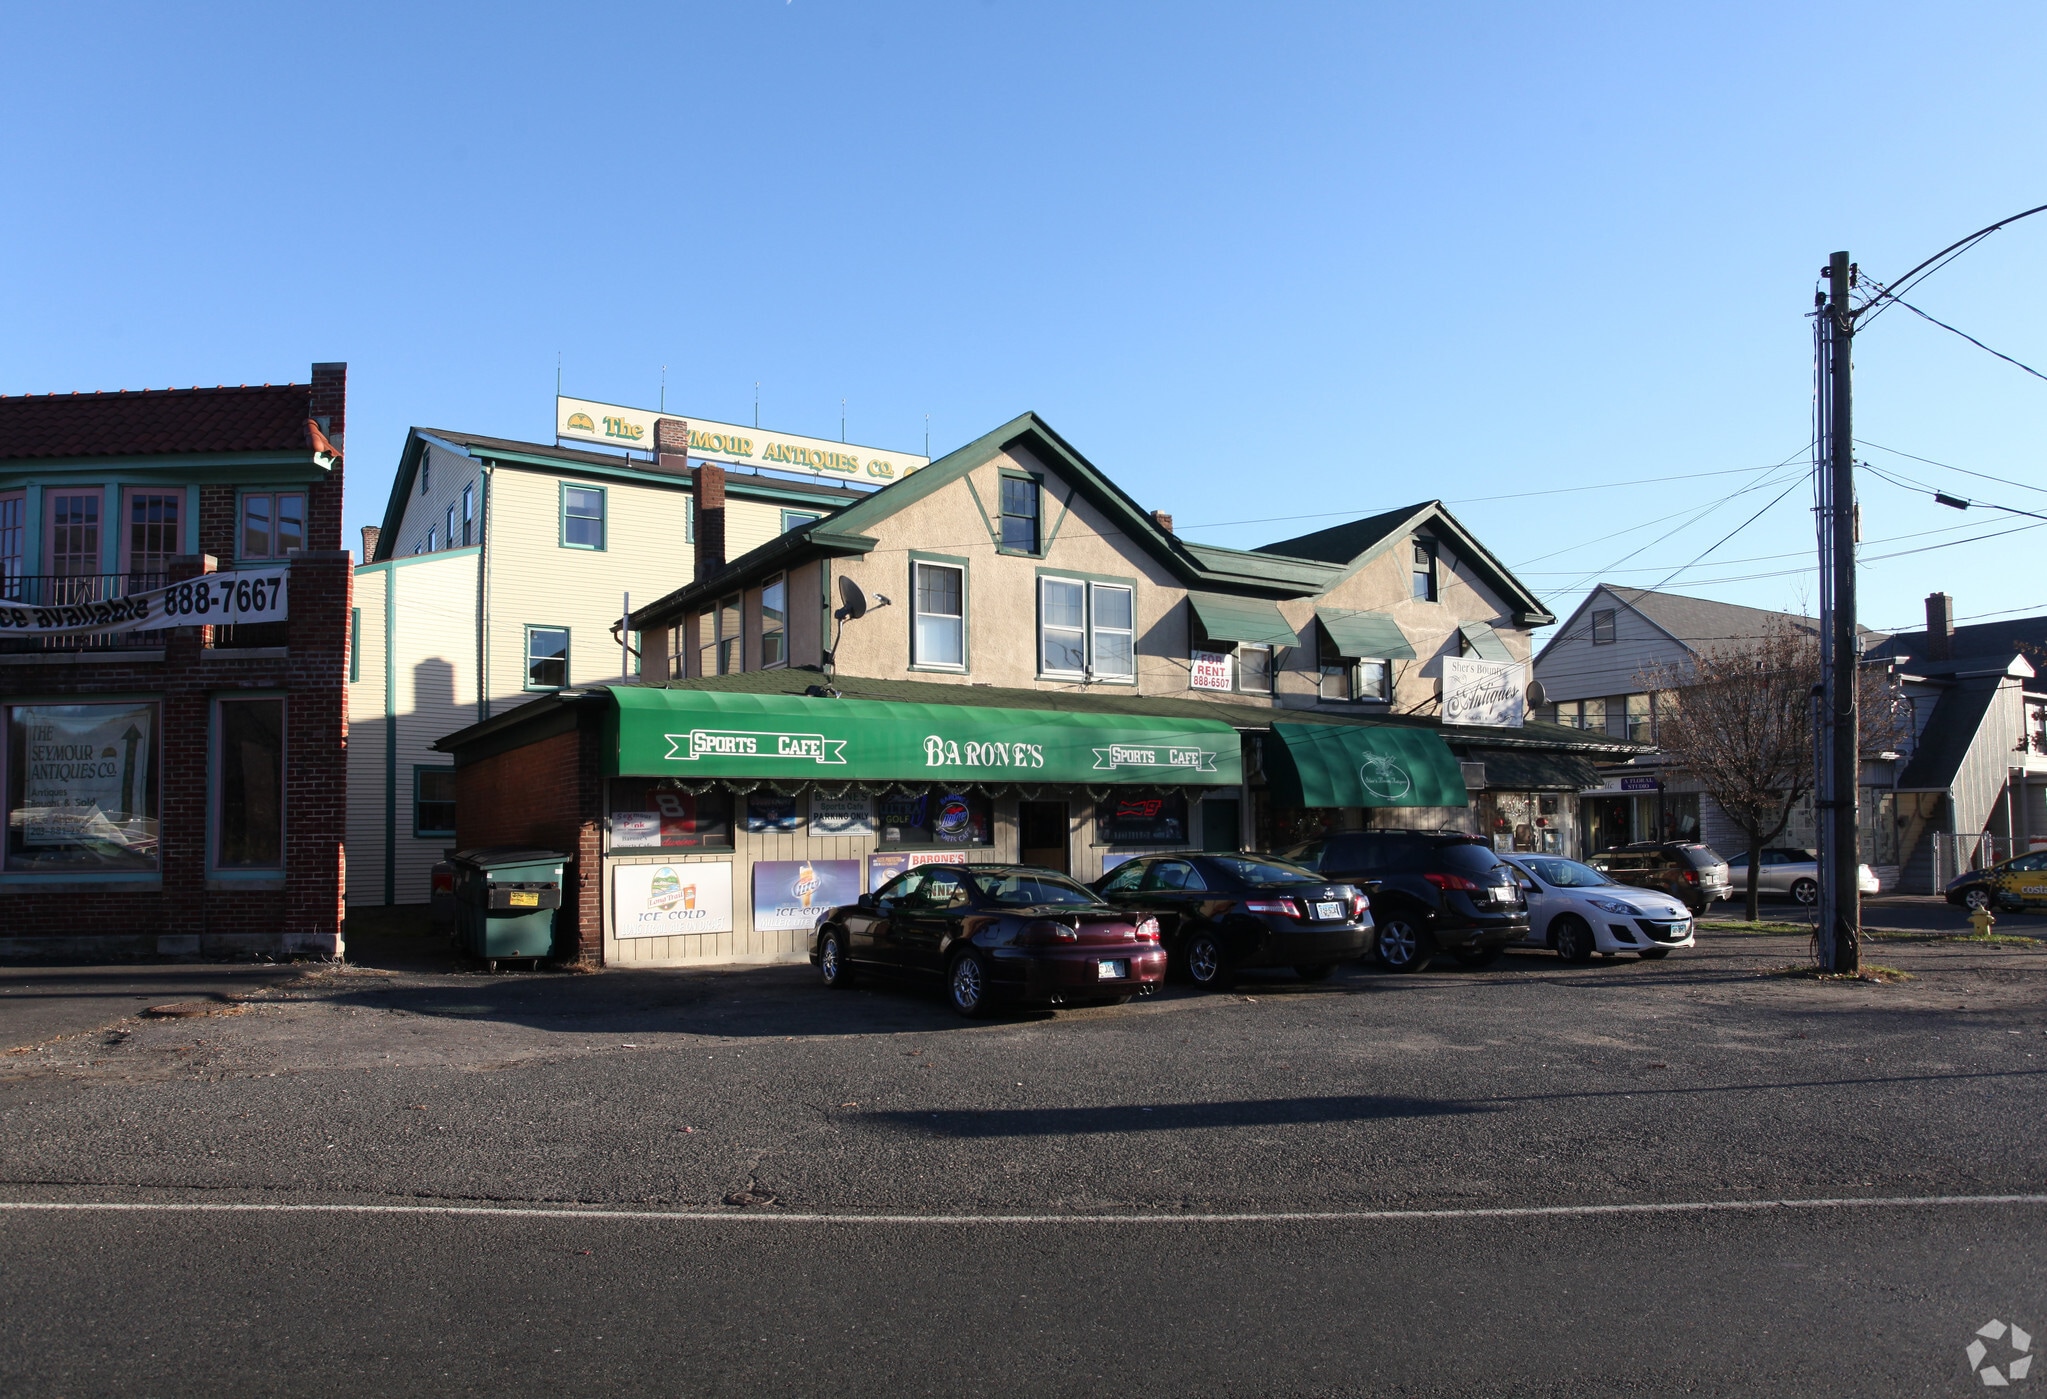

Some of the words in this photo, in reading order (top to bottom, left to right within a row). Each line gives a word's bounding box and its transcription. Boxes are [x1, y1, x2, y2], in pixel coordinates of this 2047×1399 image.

[603, 415, 644, 441] The
[761, 442, 860, 473] ANTIQUES
[867, 458, 894, 479] CO.
[32, 596, 149, 628] available
[164, 577, 281, 616] 888-7667
[1201, 654, 1222, 665] FOR
[1452, 661, 1474, 674] Sher's
[1197, 665, 1226, 677] RENT
[1448, 682, 1520, 719] Antiques
[33, 725, 54, 741] THE
[32, 745, 93, 761] SEYMOUR
[923, 735, 1044, 769] BARONE'S
[32, 763, 96, 782] ANTIQUES
[655, 794, 685, 817] 8
[821, 802, 846, 811] Sports
[851, 812, 869, 820] ONLY
[912, 854, 965, 865] BARONE'S
[638, 912, 662, 921] ICE
[668, 909, 706, 920] COLD
